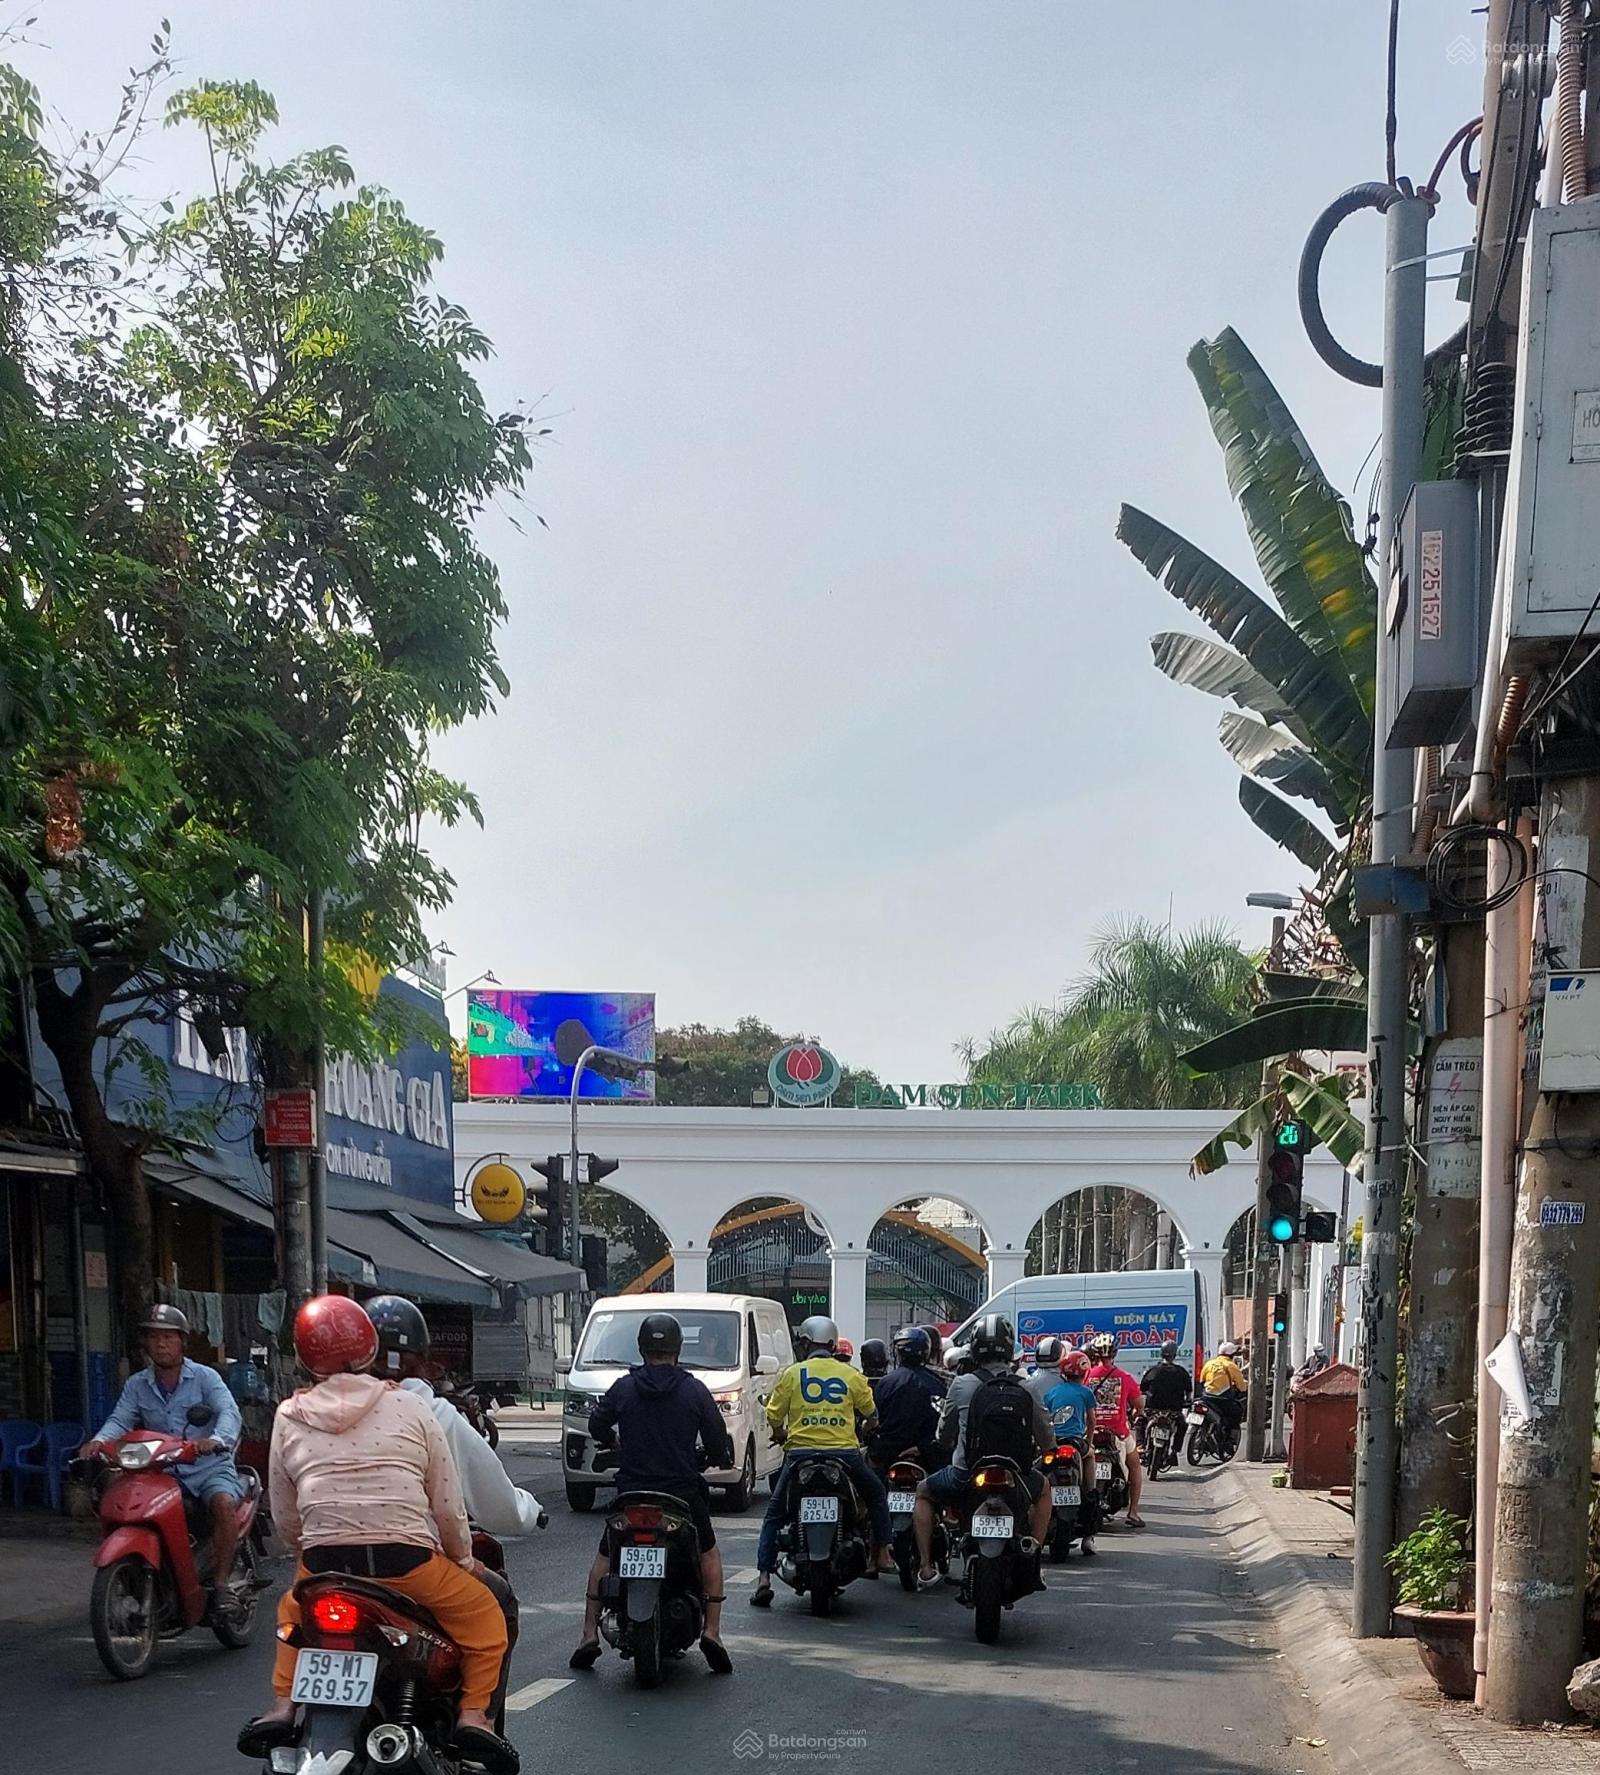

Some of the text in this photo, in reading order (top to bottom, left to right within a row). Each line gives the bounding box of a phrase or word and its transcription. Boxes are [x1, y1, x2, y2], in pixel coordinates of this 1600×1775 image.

[1014, 1084, 1102, 1106] PARK
[407, 1071, 449, 1149] GIA
[432, 1332, 467, 1341] EAFOOD
[1116, 1325, 1179, 1347] TOÀN
[800, 1368, 848, 1404] be
[621, 1563, 663, 1577] 887.33
[309, 1653, 362, 1678] 59-M1
[297, 1677, 368, 1702] 269.57
